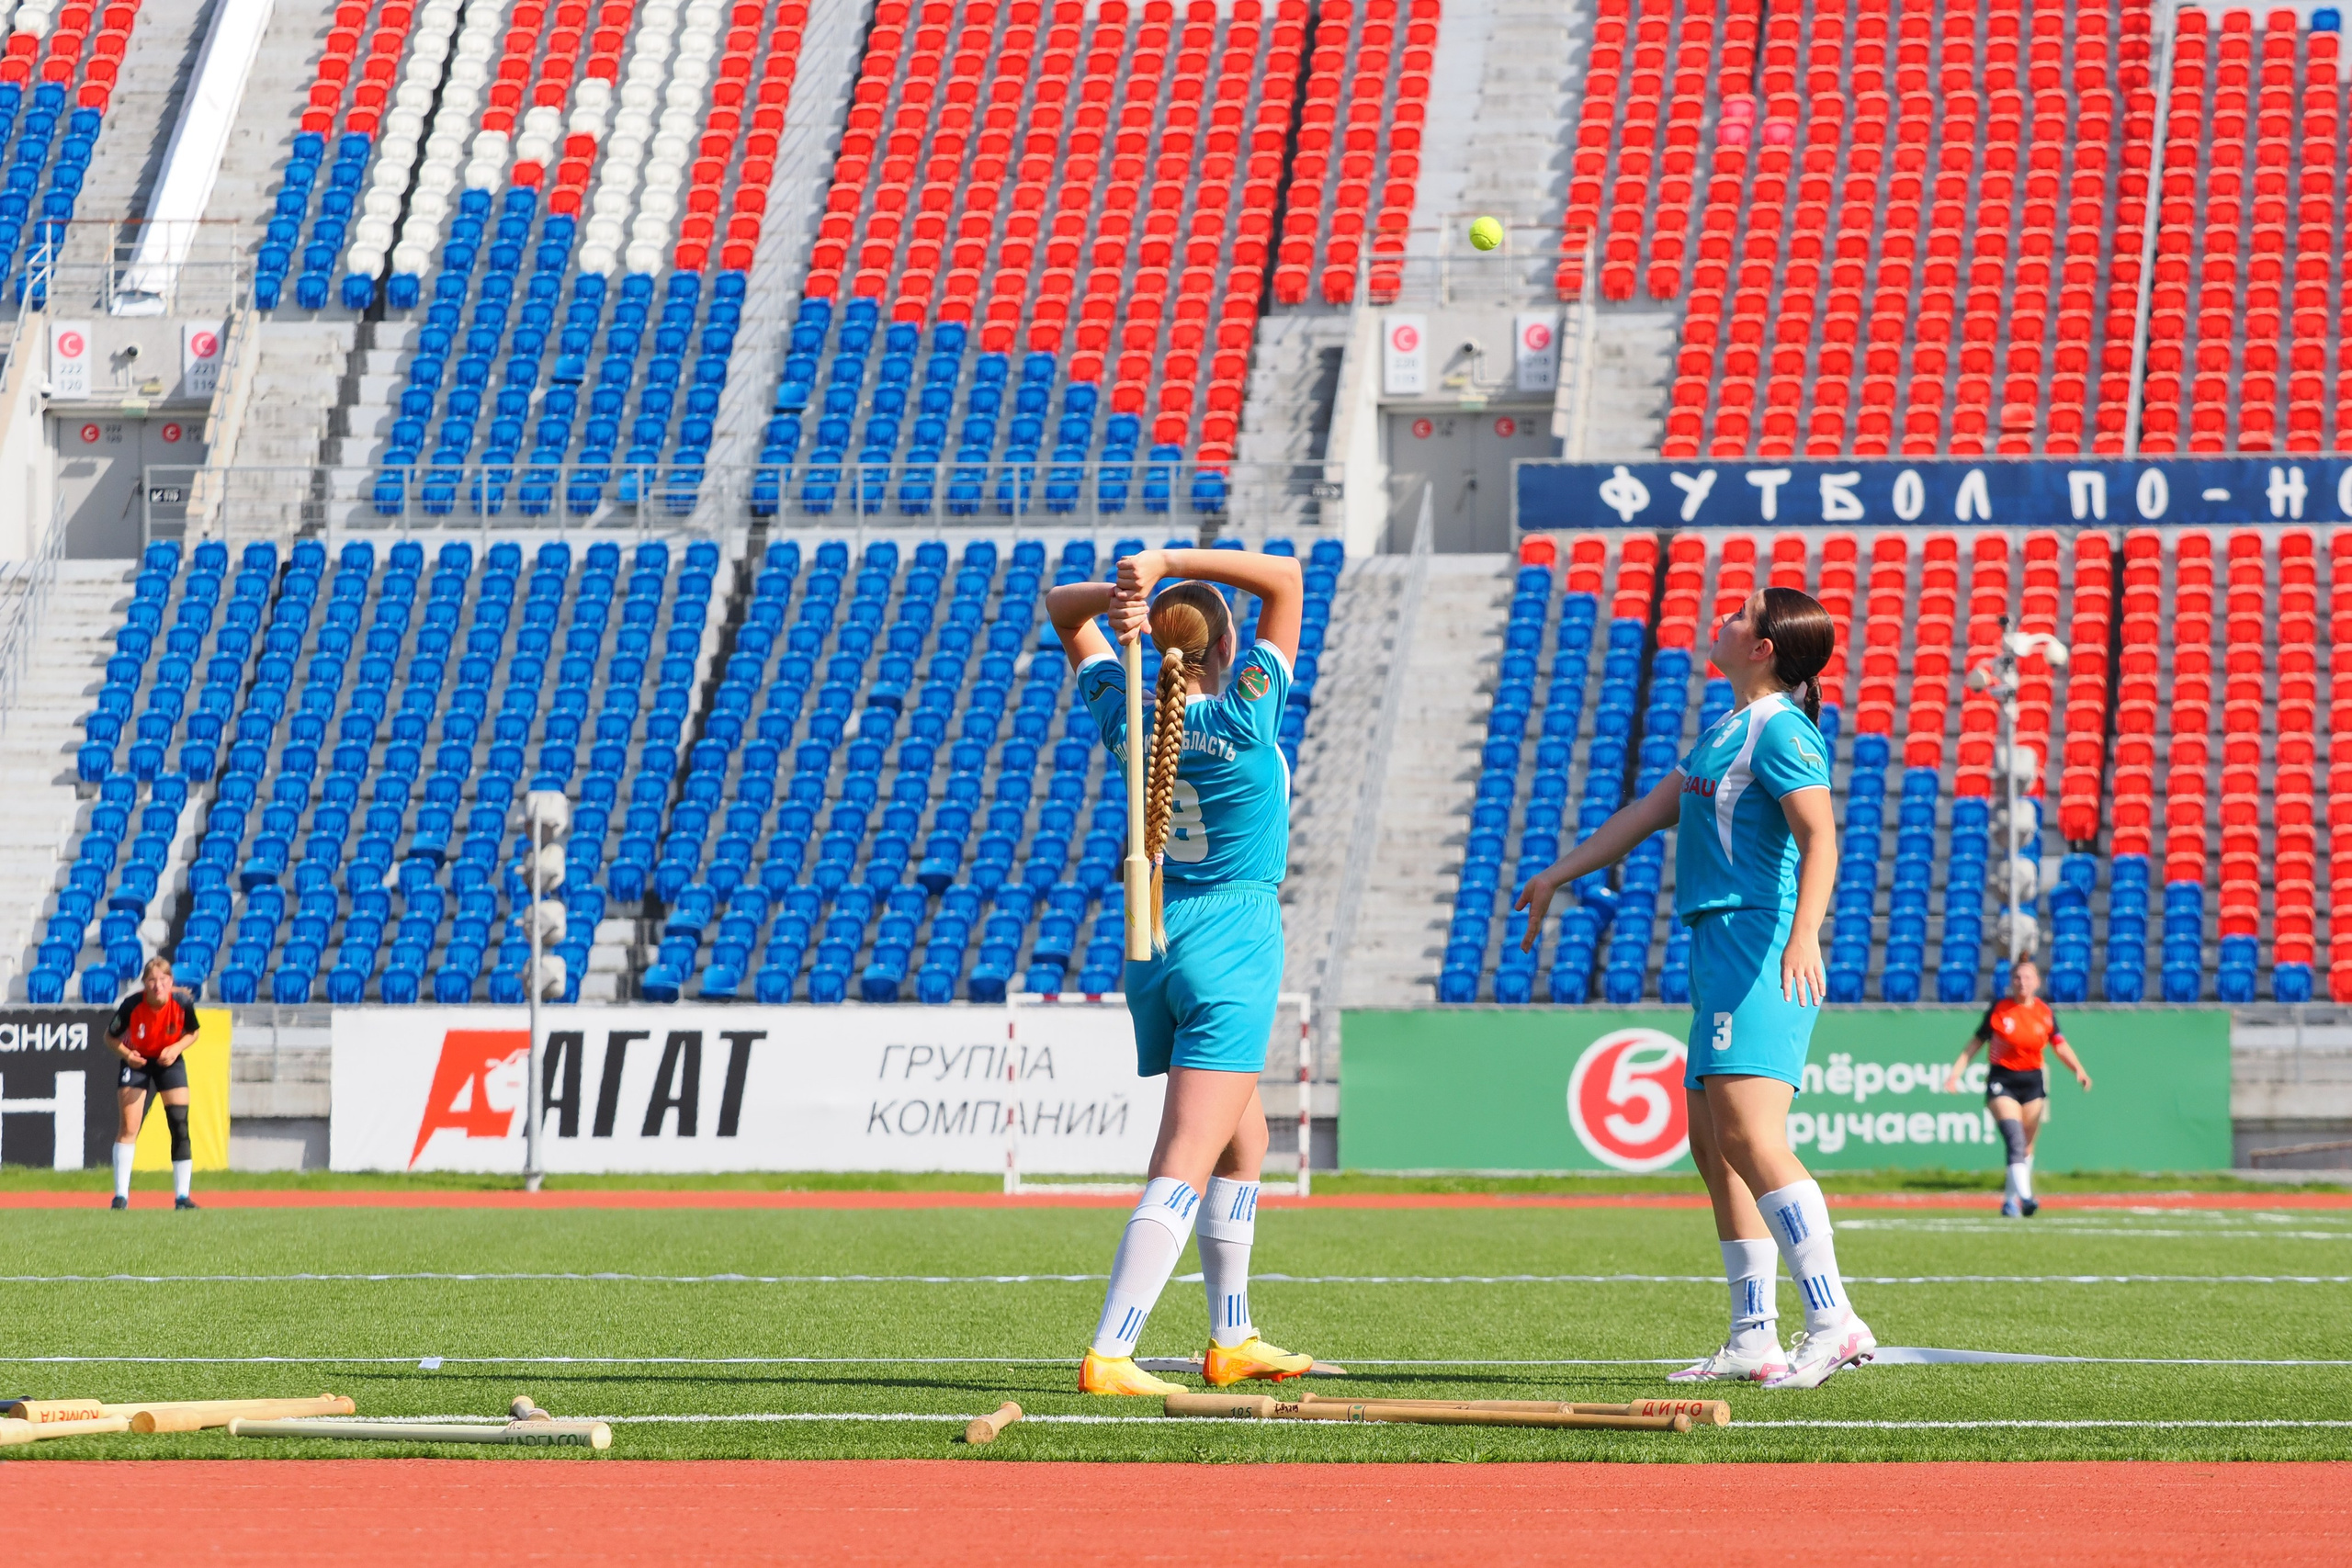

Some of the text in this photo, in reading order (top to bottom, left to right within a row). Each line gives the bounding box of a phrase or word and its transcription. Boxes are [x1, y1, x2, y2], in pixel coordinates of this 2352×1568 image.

[60, 363, 83, 375] 222
[60, 379, 83, 391] 120
[194, 363, 216, 375] 221
[1599, 465, 1992, 522] ФУТБОЛ
[1181, 730, 1238, 762] БЛАСТЬ
[1712, 718, 1743, 749] 3
[1712, 1011, 1733, 1050] 3
[879, 1045, 1054, 1081] ГРУППА
[1800, 1053, 1989, 1103] тёрочка
[522, 1030, 768, 1138] АГАТ
[1604, 1039, 1674, 1145] 5
[1786, 1108, 1996, 1154] ручает!
[1230, 1406, 1252, 1417] 105
[1642, 1401, 1702, 1416] ДИНО
